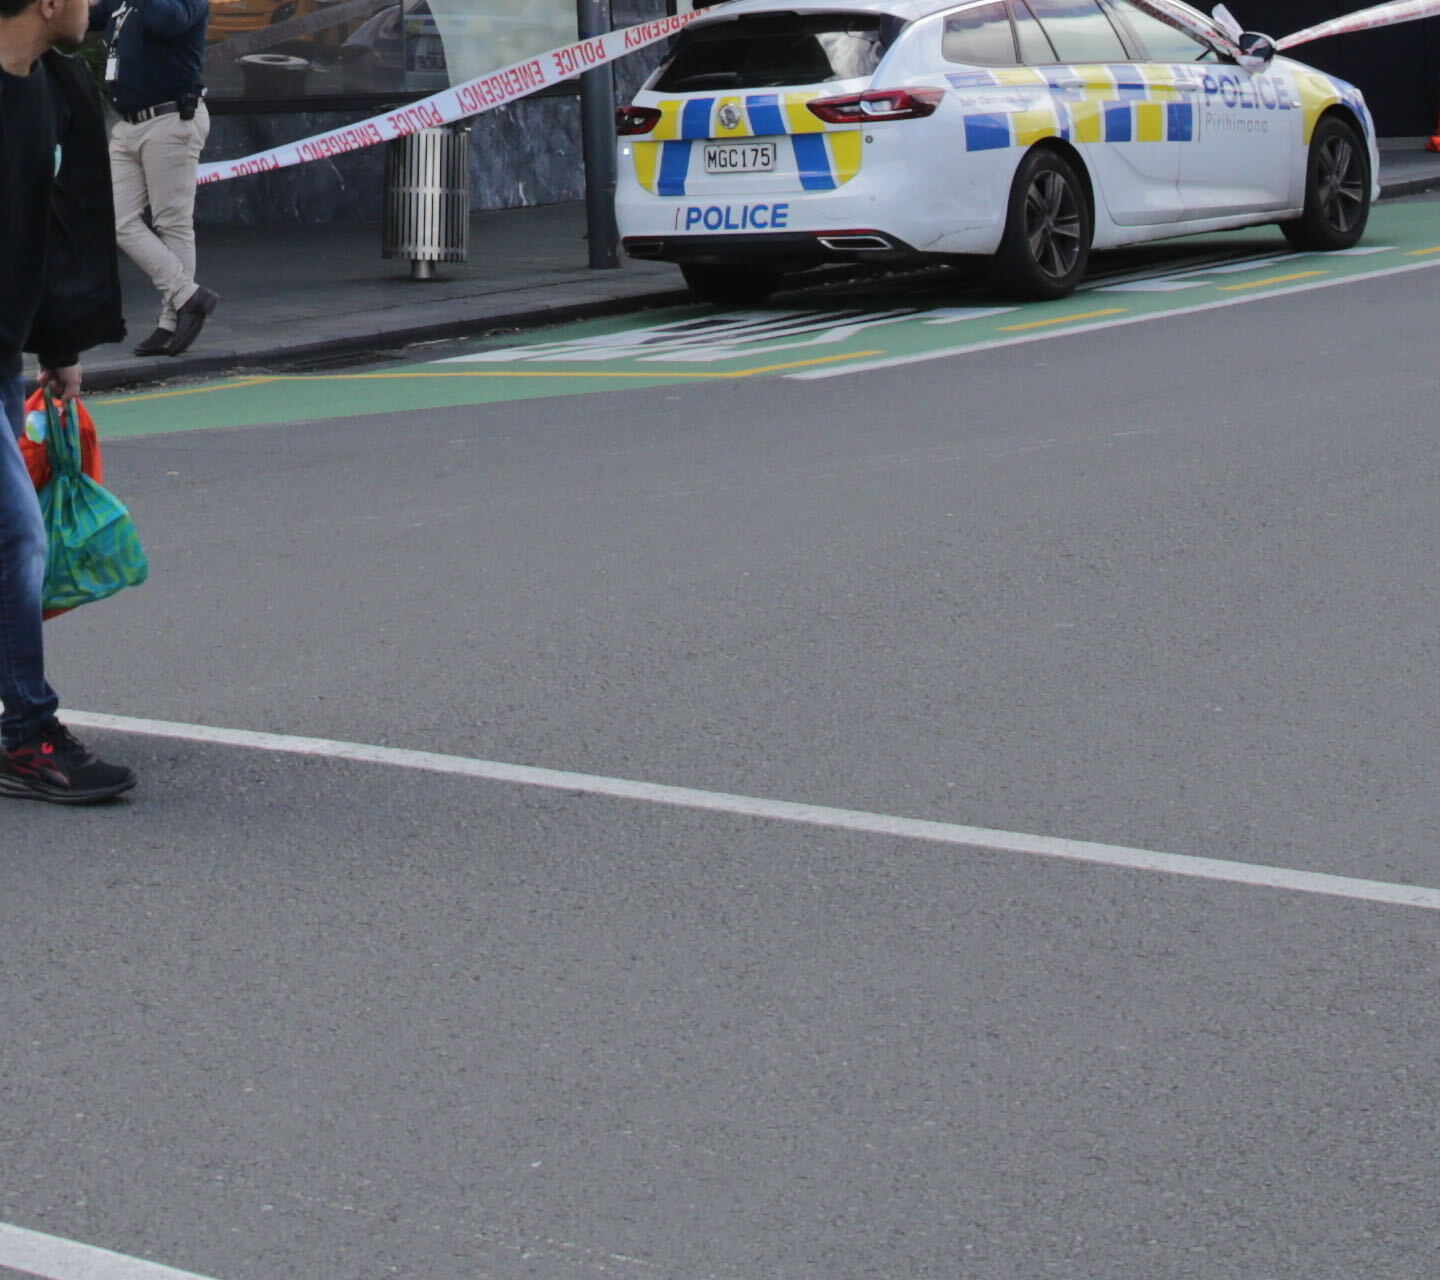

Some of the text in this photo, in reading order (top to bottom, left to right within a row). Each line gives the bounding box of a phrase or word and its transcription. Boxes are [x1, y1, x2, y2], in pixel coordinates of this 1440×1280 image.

[551, 37, 607, 77] POLICE
[454, 58, 546, 115] EMERGENCY
[1203, 74, 1291, 111] POLICE
[387, 99, 445, 138] POLICE
[1205, 111, 1268, 134] Pirihimana
[294, 122, 384, 165] EMERGENCY
[707, 147, 771, 169] MGC175
[685, 203, 789, 231] POLICE
